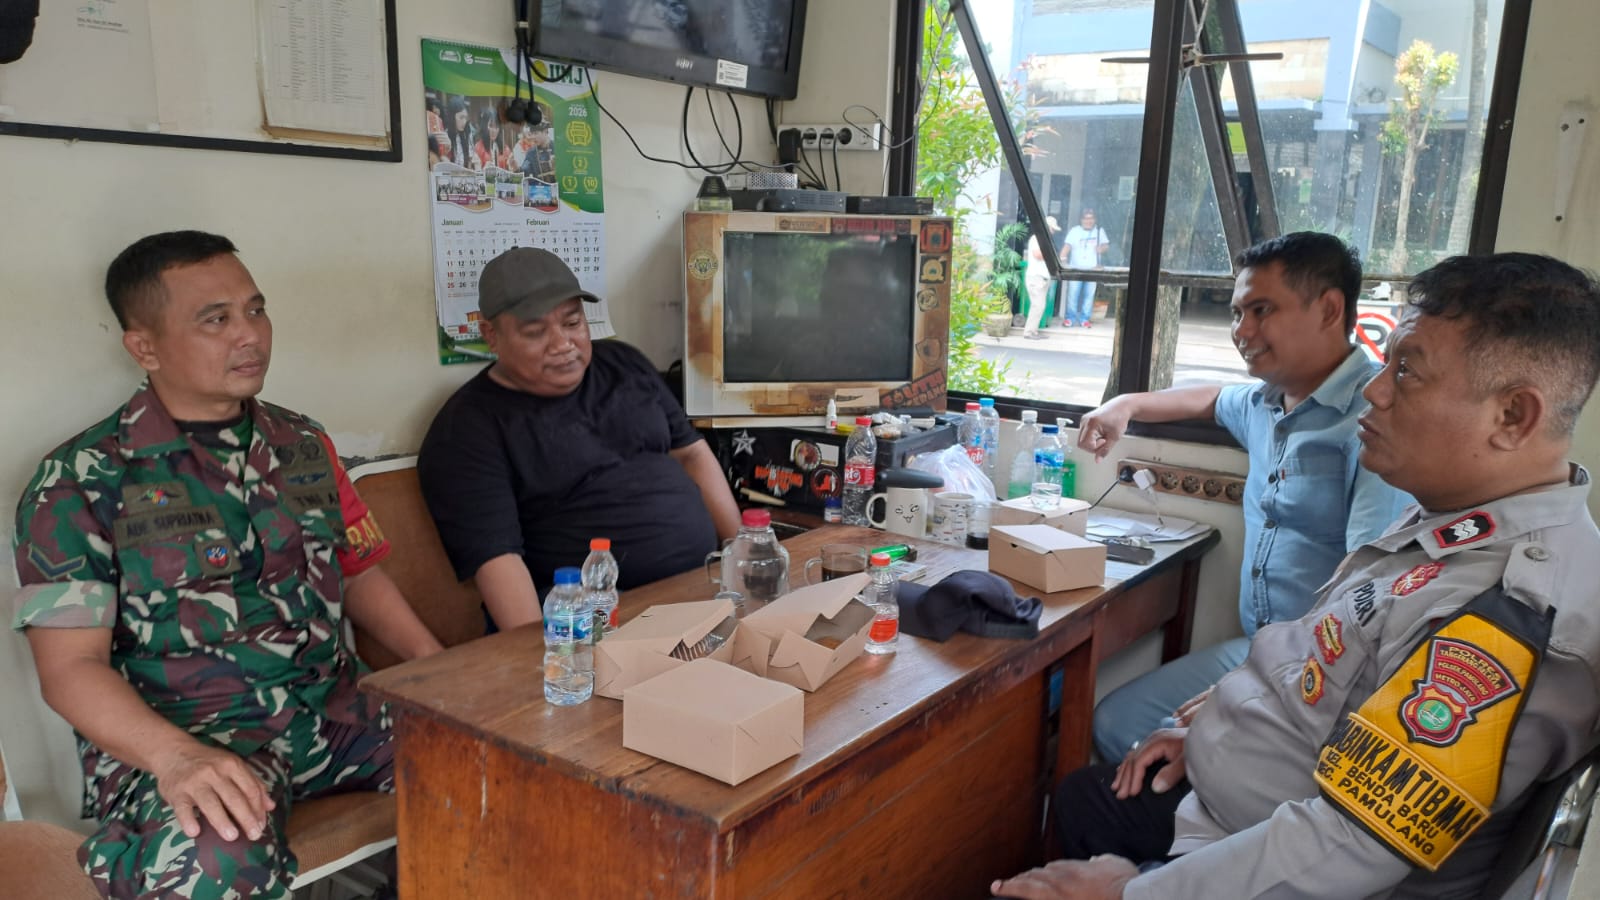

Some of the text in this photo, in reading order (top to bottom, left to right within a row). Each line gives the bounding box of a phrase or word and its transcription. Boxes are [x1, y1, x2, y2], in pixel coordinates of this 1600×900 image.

[568, 107, 588, 118] 2026
[441, 218, 464, 226] Januari
[1353, 582, 1376, 628] POLRI
[1449, 646, 1501, 680] POLRES
[1435, 674, 1477, 702] METRO JAYA
[1338, 777, 1435, 855] PAMULANG
[1346, 766, 1395, 807] BENDA
[1397, 804, 1439, 839] BARU
